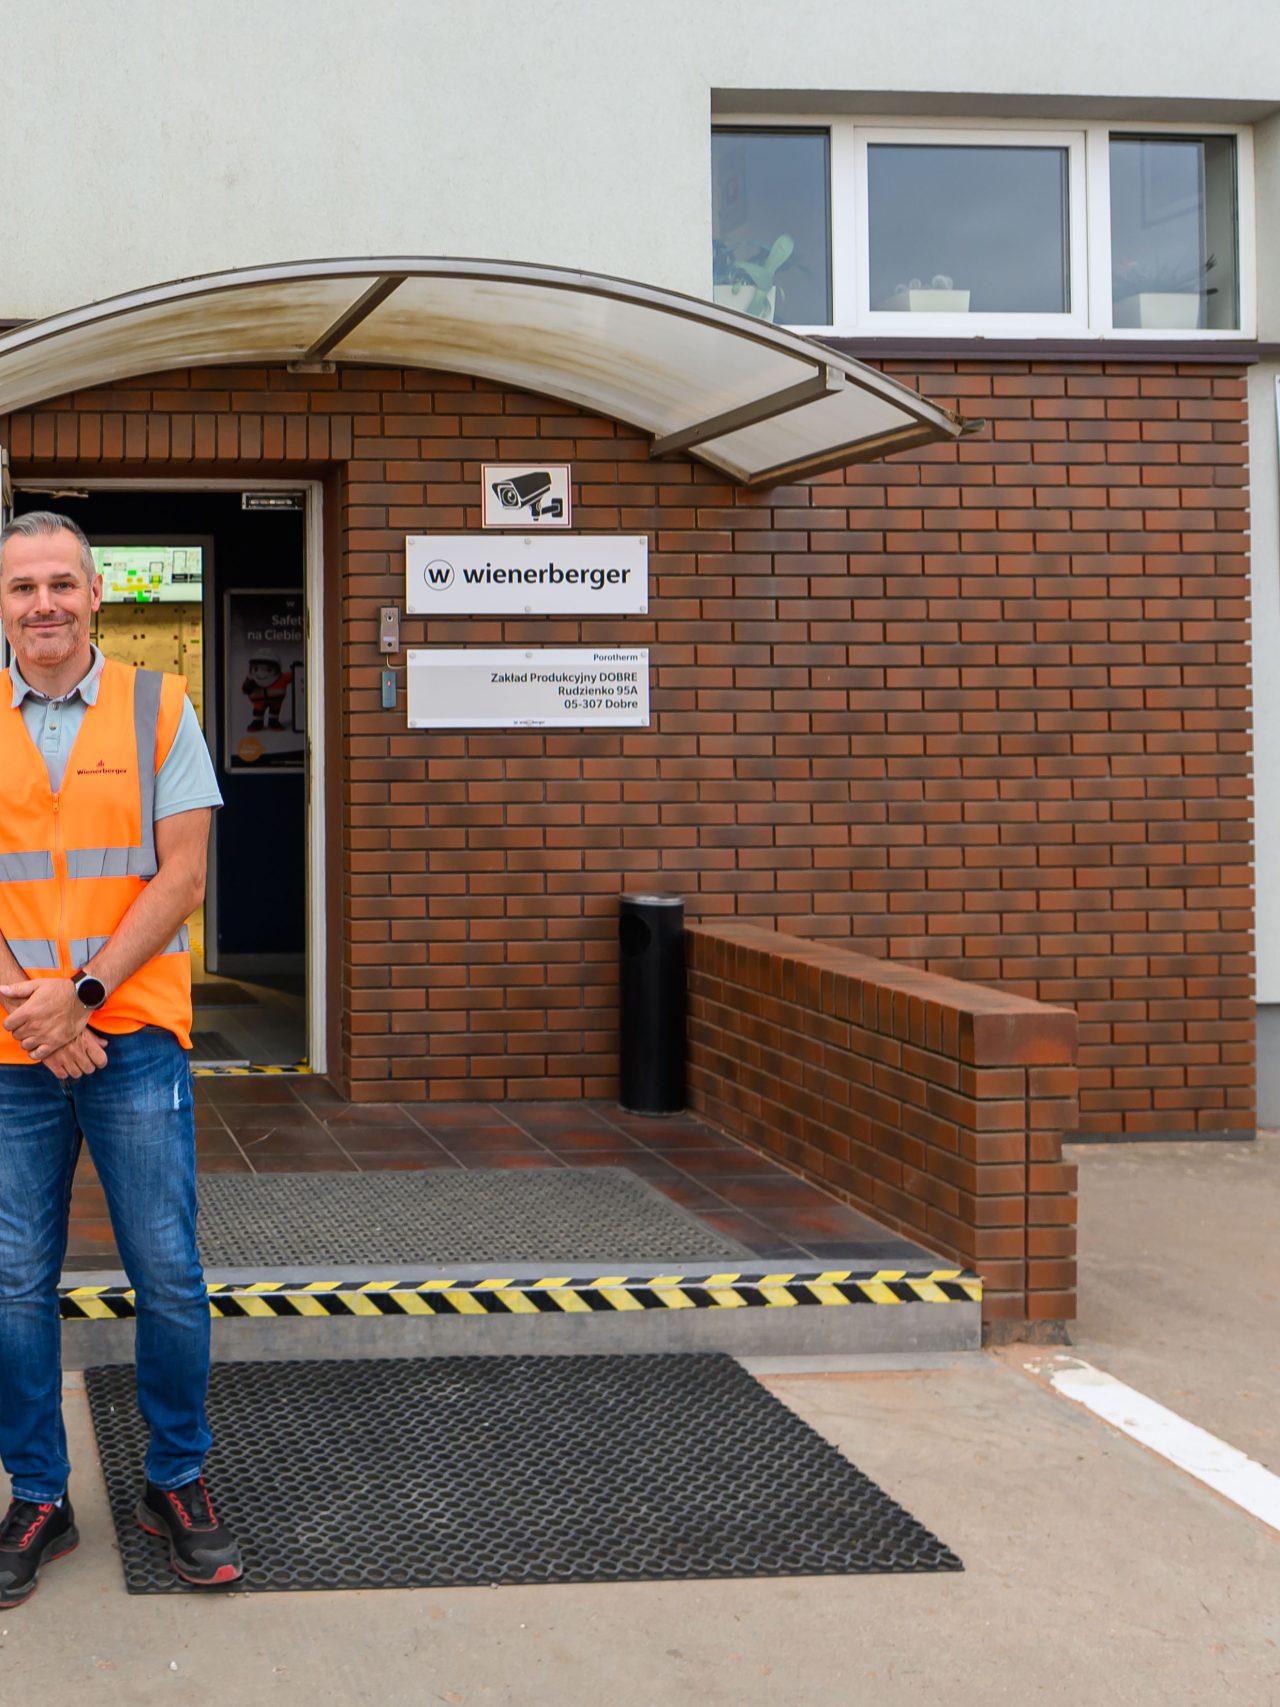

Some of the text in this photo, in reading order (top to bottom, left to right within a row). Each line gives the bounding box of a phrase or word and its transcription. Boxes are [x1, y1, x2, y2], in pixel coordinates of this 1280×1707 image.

[463, 562, 631, 590] wienerberger
[272, 614, 303, 626] Safet
[248, 630, 262, 641] na
[593, 653, 638, 661] Porotherm
[491, 672, 638, 685] Zakład Produkcyjny DOBRE
[558, 685, 638, 696] Rudzienko 95A
[564, 699, 638, 710] 05-307 Dobre
